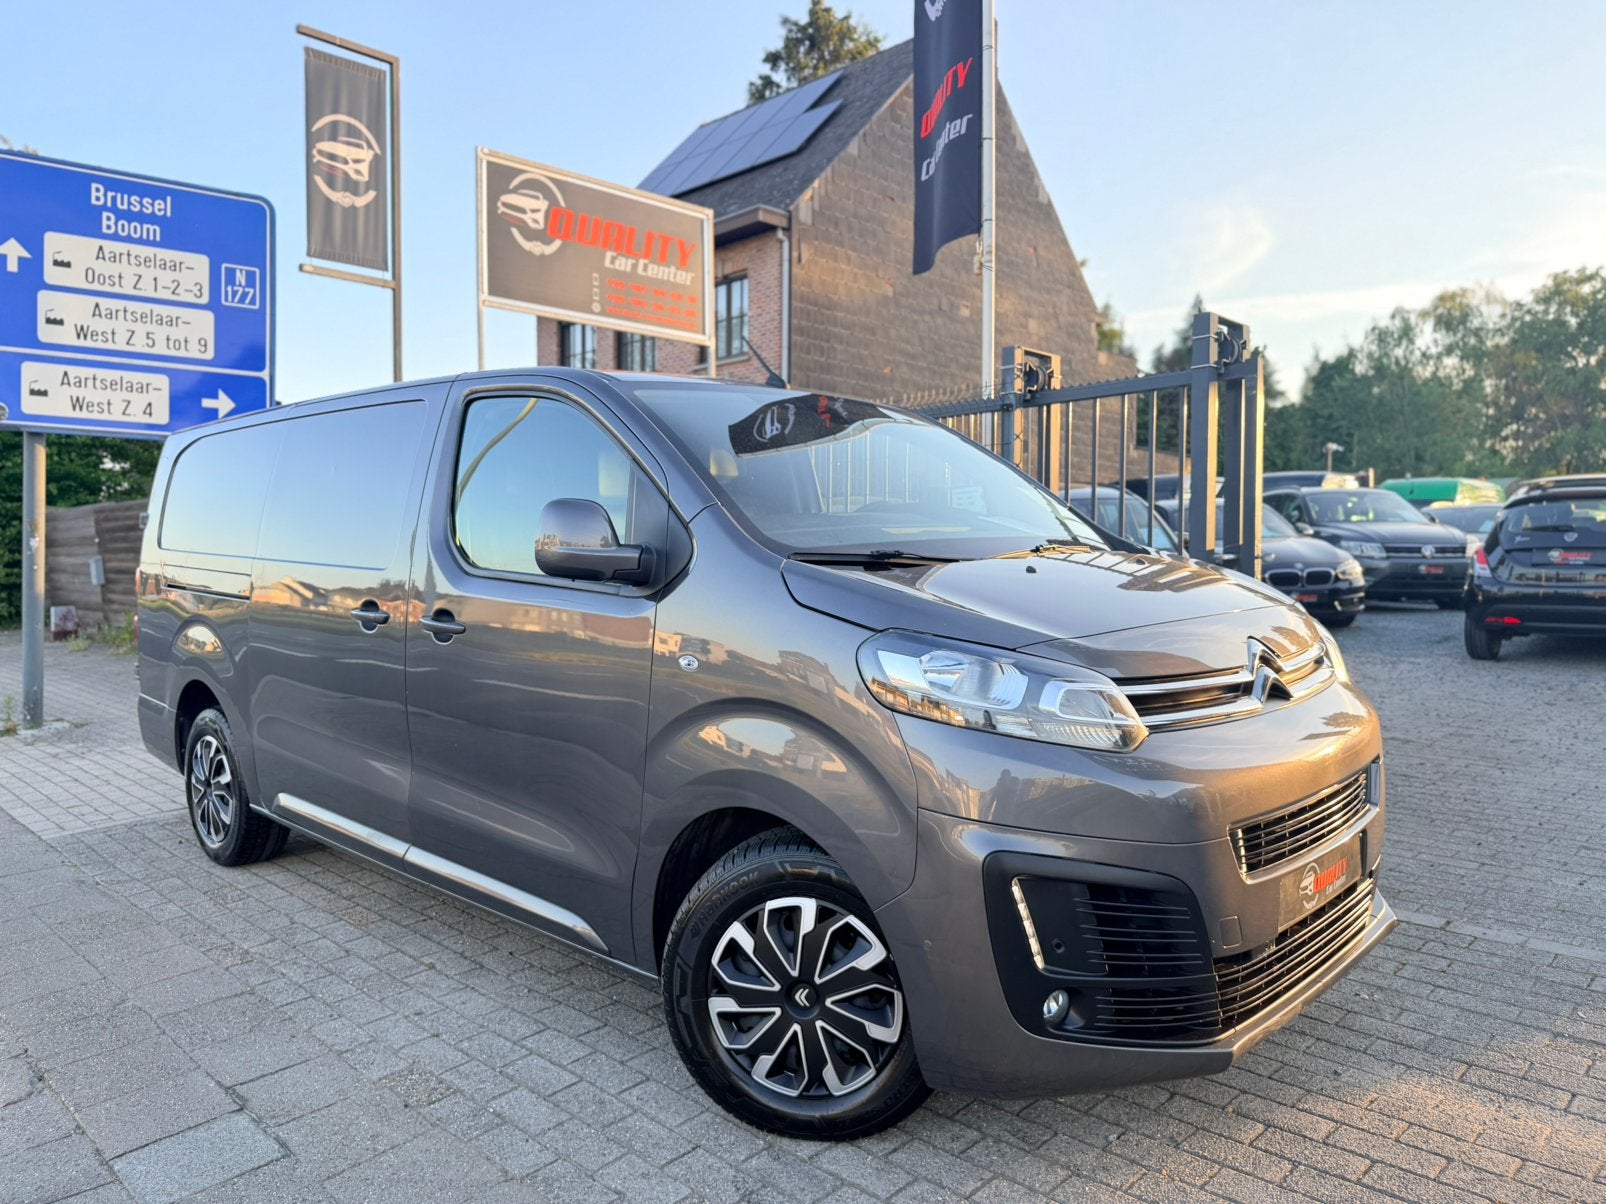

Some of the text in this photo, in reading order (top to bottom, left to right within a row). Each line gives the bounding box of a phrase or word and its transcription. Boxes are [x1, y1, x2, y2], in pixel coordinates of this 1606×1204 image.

[90, 182, 172, 218] Brussel
[101, 211, 161, 242] Boom
[546, 206, 697, 270] QUALITY
[95, 244, 195, 273] Aartselaar-
[604, 251, 696, 286] Car Center
[85, 266, 124, 288] Oost
[235, 268, 246, 286] N
[226, 285, 254, 305] 177
[91, 302, 192, 328] Aartselaar-
[74, 323, 117, 345] West
[165, 334, 190, 352] tot
[197, 336, 208, 354] 9
[60, 370, 163, 394] Aartselaar-
[70, 395, 113, 416] West
